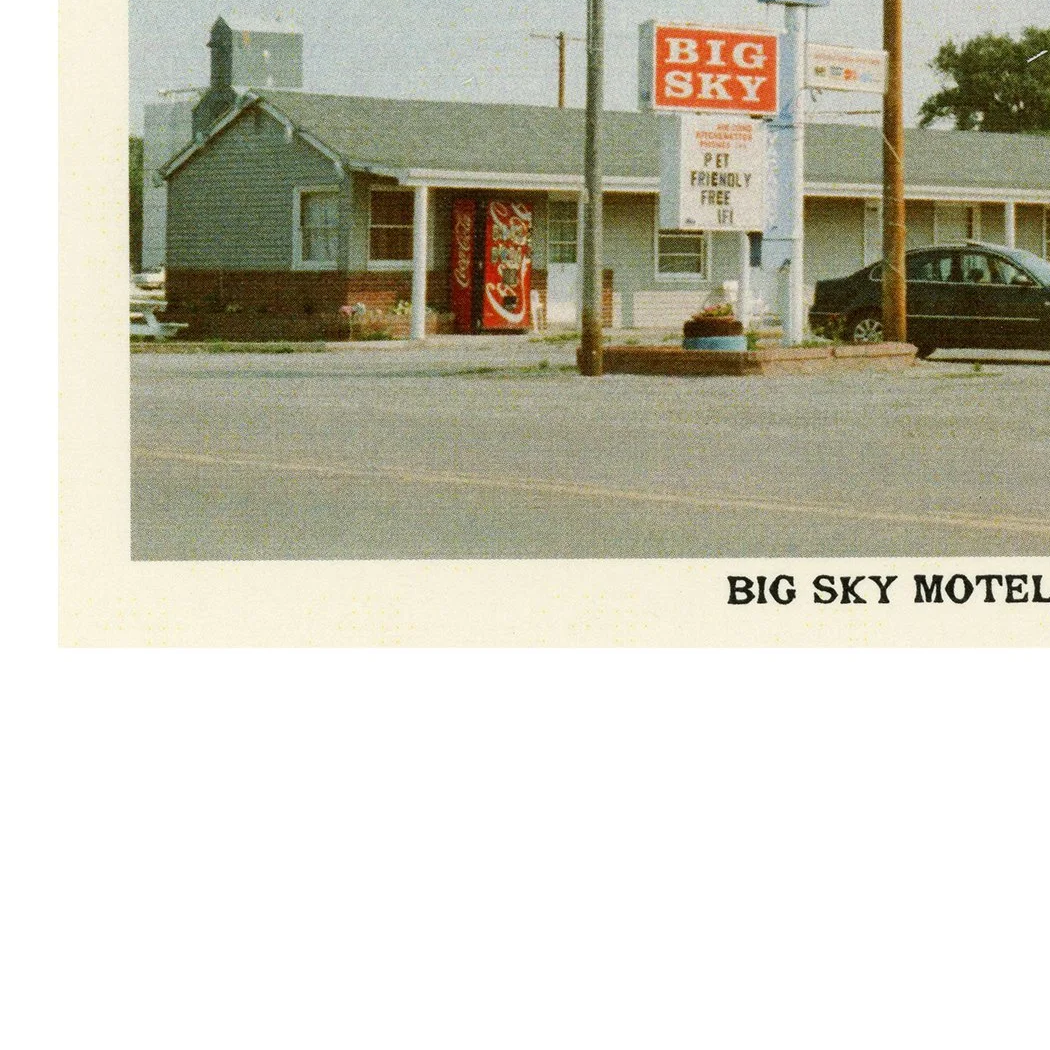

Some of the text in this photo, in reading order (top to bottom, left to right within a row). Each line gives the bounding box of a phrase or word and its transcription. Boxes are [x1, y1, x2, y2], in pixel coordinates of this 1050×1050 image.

[664, 36, 768, 70] BIG
[663, 70, 767, 103] SKY
[703, 152, 730, 168] PET
[690, 170, 753, 188] FRIENDLY
[700, 189, 731, 206] FREE
